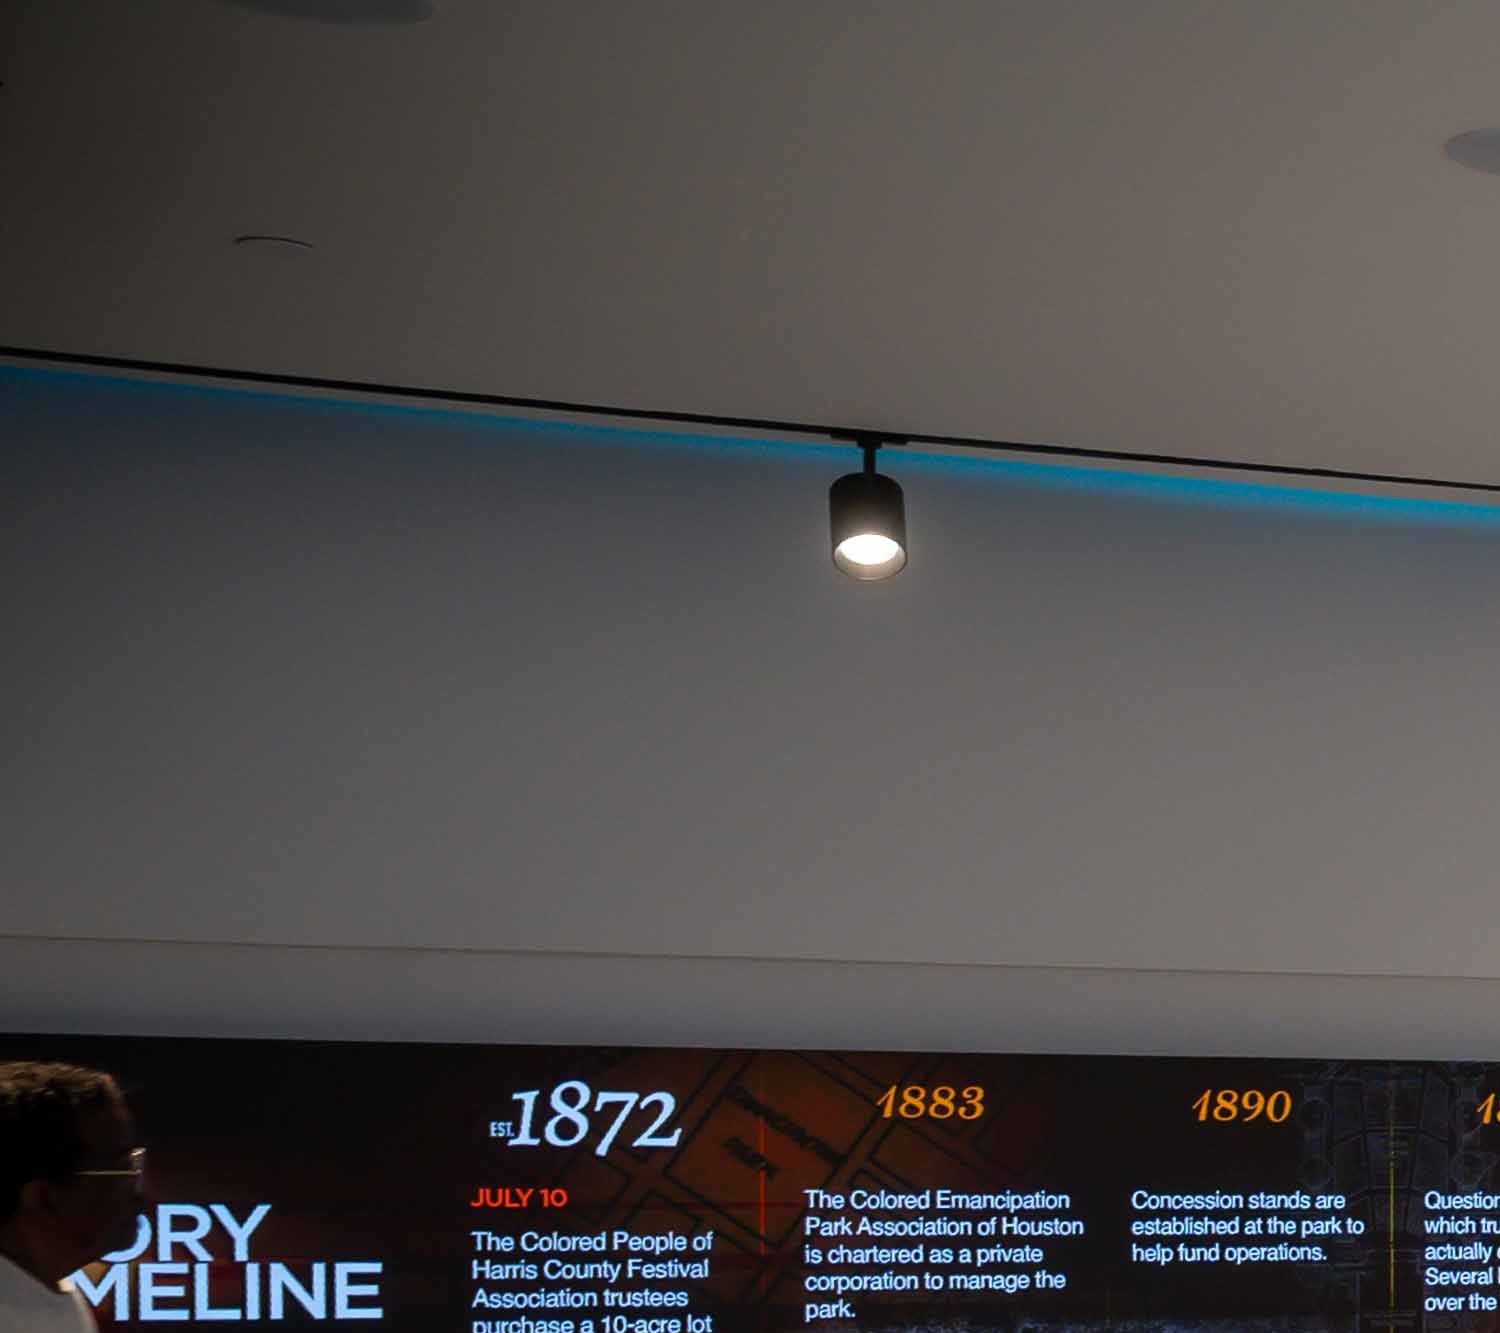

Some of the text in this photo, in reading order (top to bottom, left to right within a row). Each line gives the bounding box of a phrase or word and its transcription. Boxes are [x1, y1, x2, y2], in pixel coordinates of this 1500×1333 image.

[875, 1086, 985, 1121] 1883
[1190, 1090, 1293, 1123] 1890
[489, 1121, 515, 1138] EST.
[508, 1079, 683, 1157] 1872
[471, 1188, 568, 1208] JULY 10
[804, 1189, 1070, 1214] The Colored Emancipation
[1131, 1190, 1346, 1210] Concession stands are
[804, 1216, 1084, 1237] Park Association of Houston
[1424, 1215, 1477, 1235] which
[471, 1230, 714, 1256] The Colored People of
[1132, 1242, 1327, 1266] help fund operations.
[1424, 1241, 1493, 1264] actually
[472, 1258, 709, 1283] Harris County Festival
[804, 1269, 1066, 1295] corporation to manage the
[1424, 1266, 1494, 1286] Several
[472, 1287, 689, 1309] Association trustees
[805, 1298, 856, 1323] park.
[686, 1314, 713, 1333] lot
